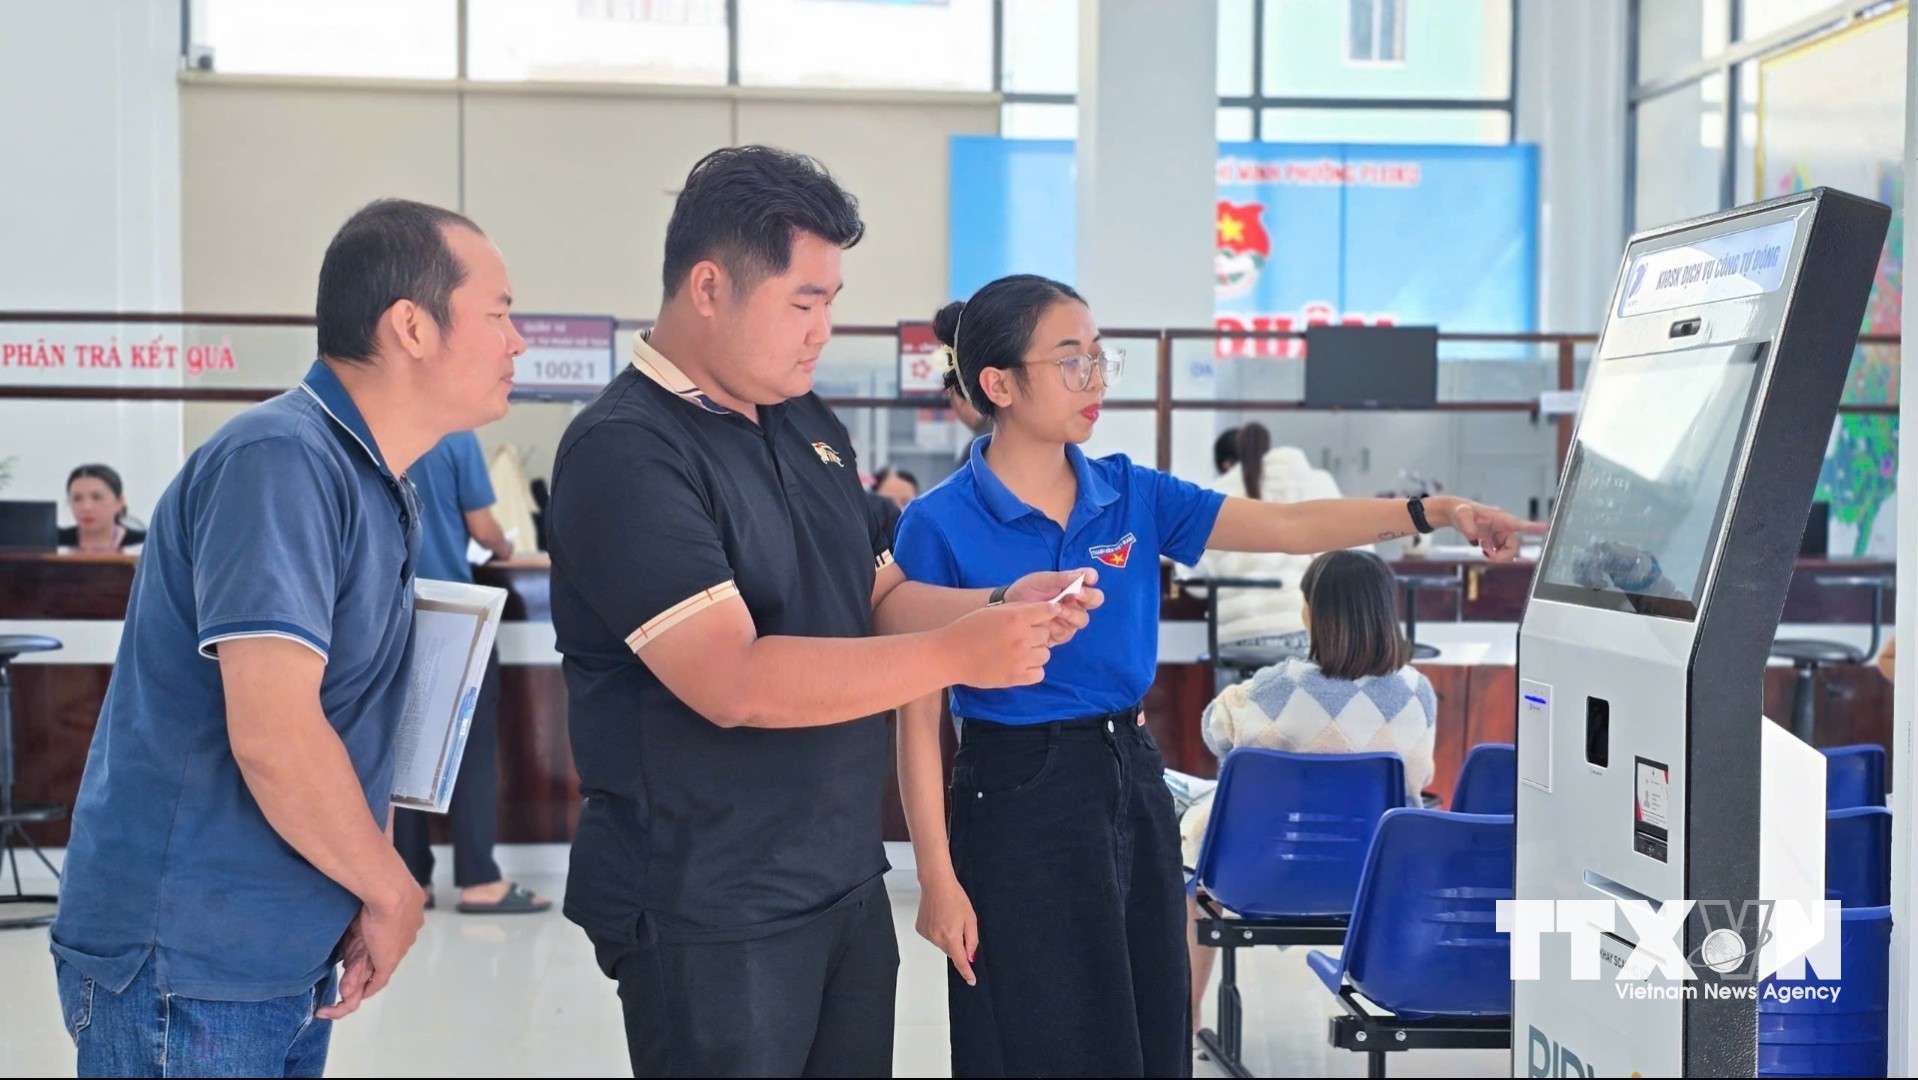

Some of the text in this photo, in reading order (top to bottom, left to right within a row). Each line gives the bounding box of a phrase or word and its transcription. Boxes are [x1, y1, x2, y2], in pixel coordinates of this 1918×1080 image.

[1655, 266, 1684, 290] KIOSK
[1701, 261, 1715, 285] VỤ
[1714, 252, 1741, 279] CÔNG
[1742, 251, 1756, 277] TỰ
[74, 336, 122, 368] TRẢ
[131, 334, 178, 368] KẾT
[534, 361, 596, 379] 10021
